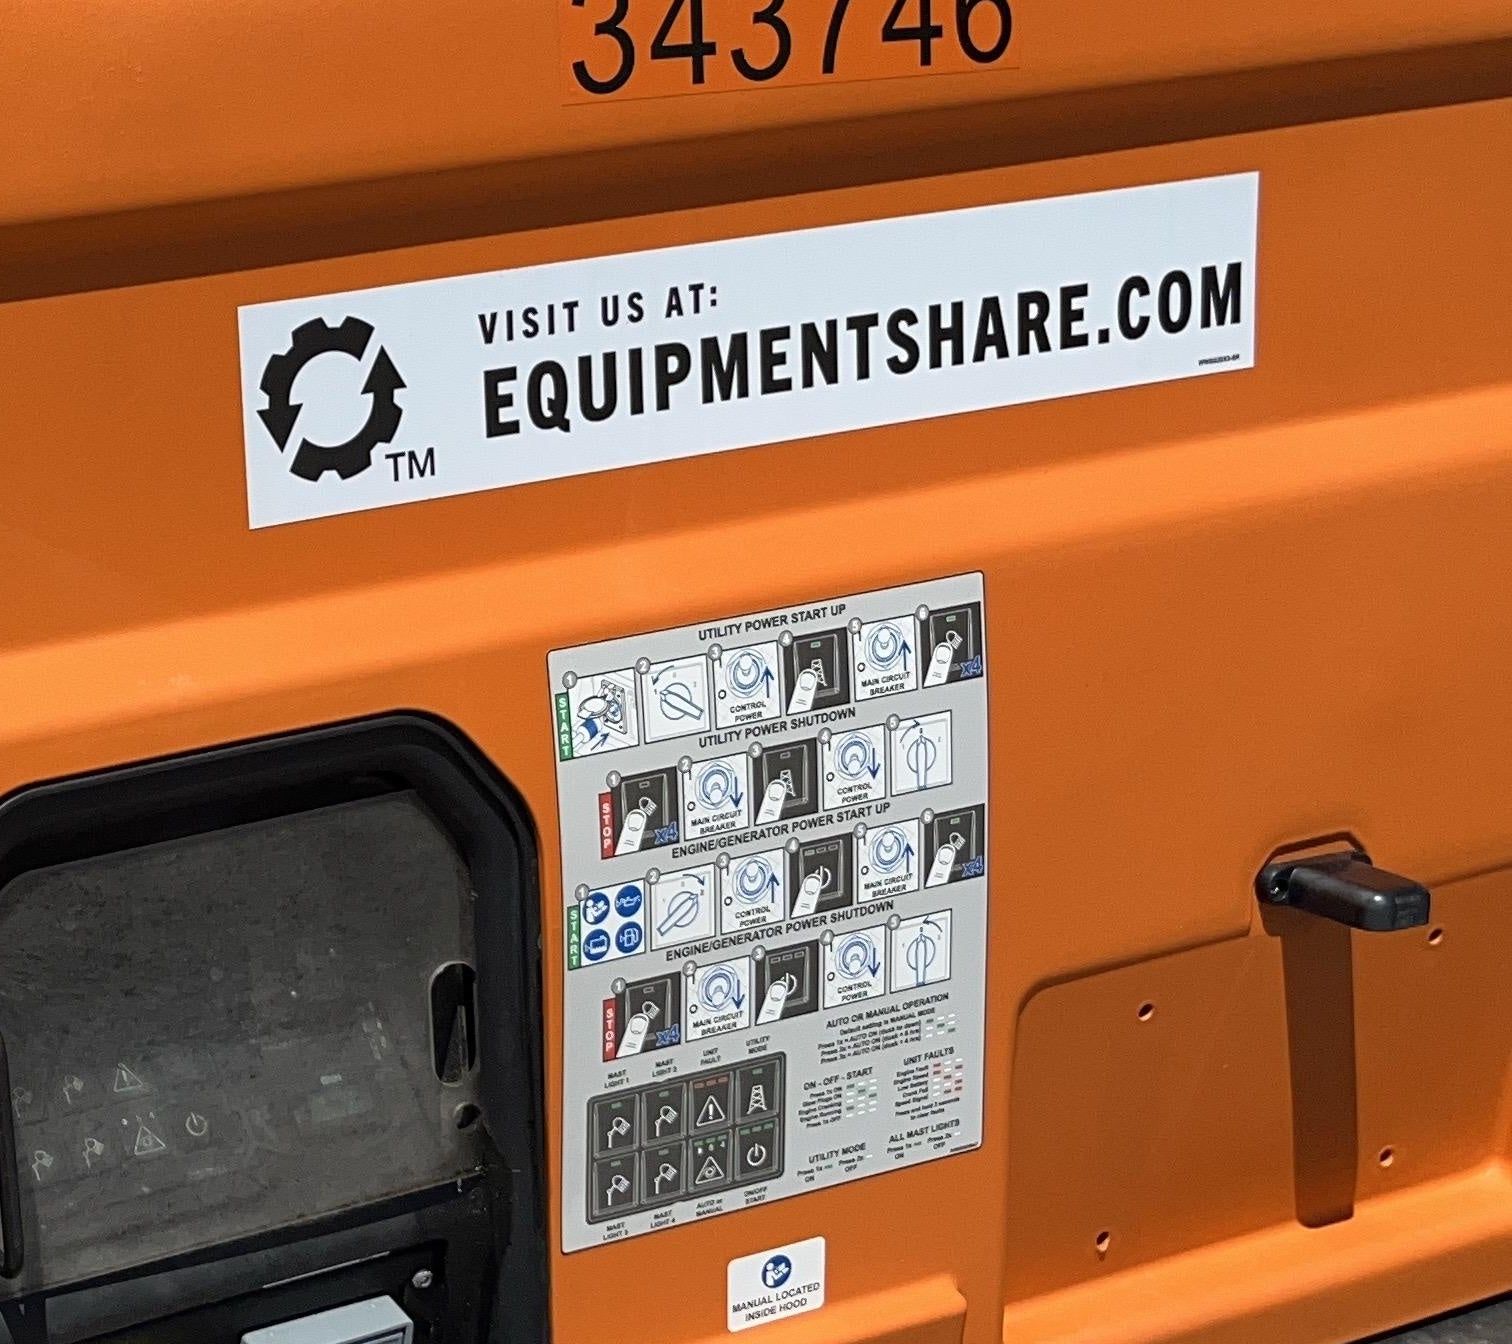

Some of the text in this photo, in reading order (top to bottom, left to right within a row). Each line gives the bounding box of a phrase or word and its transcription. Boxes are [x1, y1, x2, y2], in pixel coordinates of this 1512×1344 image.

[477, 281, 721, 346] VISIT US AT:
[483, 261, 1244, 440] EQUIPMENTSHARE.COM
[383, 445, 438, 484] TM
[698, 603, 846, 641] UTILITY POWER START UP
[861, 671, 911, 688] MAIN CIRCUIT
[869, 683, 905, 696] BREAKER
[729, 701, 767, 714] CONTROL
[734, 711, 763, 723] POWER
[557, 697, 569, 757] START
[698, 707, 856, 748] UTILITY POWER SHUTDOWN
[837, 782, 873, 796] CONTROL
[841, 792, 869, 804] POWER
[602, 803, 610, 849] STOP
[690, 809, 743, 827] MAIN CIRCUIT
[699, 820, 737, 835] BREAKER
[671, 802, 890, 859] ENGINE/GENERATOR POWER START UP
[863, 873, 913, 891] MAIN CIRCUIT
[871, 884, 907, 898] BREAKER
[735, 906, 771, 919] CONTROL
[739, 916, 767, 928] POWER
[569, 909, 578, 966] START
[666, 900, 895, 961] ENGINE/GENERATOR POWER SHUTDOWN
[837, 981, 872, 994] CONTROL
[841, 991, 868, 1002] POWER
[692, 1010, 744, 1029] MAIN CIRCUIT
[826, 1016, 850, 1029] AUTO
[865, 1003, 901, 1019] MANUAL
[902, 992, 949, 1011] OPERATION
[605, 1008, 615, 1052] STOP
[700, 1021, 737, 1036] BREAKER
[846, 1066, 873, 1080] START
[888, 1118, 960, 1144] ALL MAST LIGHTS
[808, 1142, 866, 1164] UTILITY MODE
[732, 1282, 820, 1313] MANUAL LOCATED
[745, 1297, 807, 1322] INSIDE HOOD
